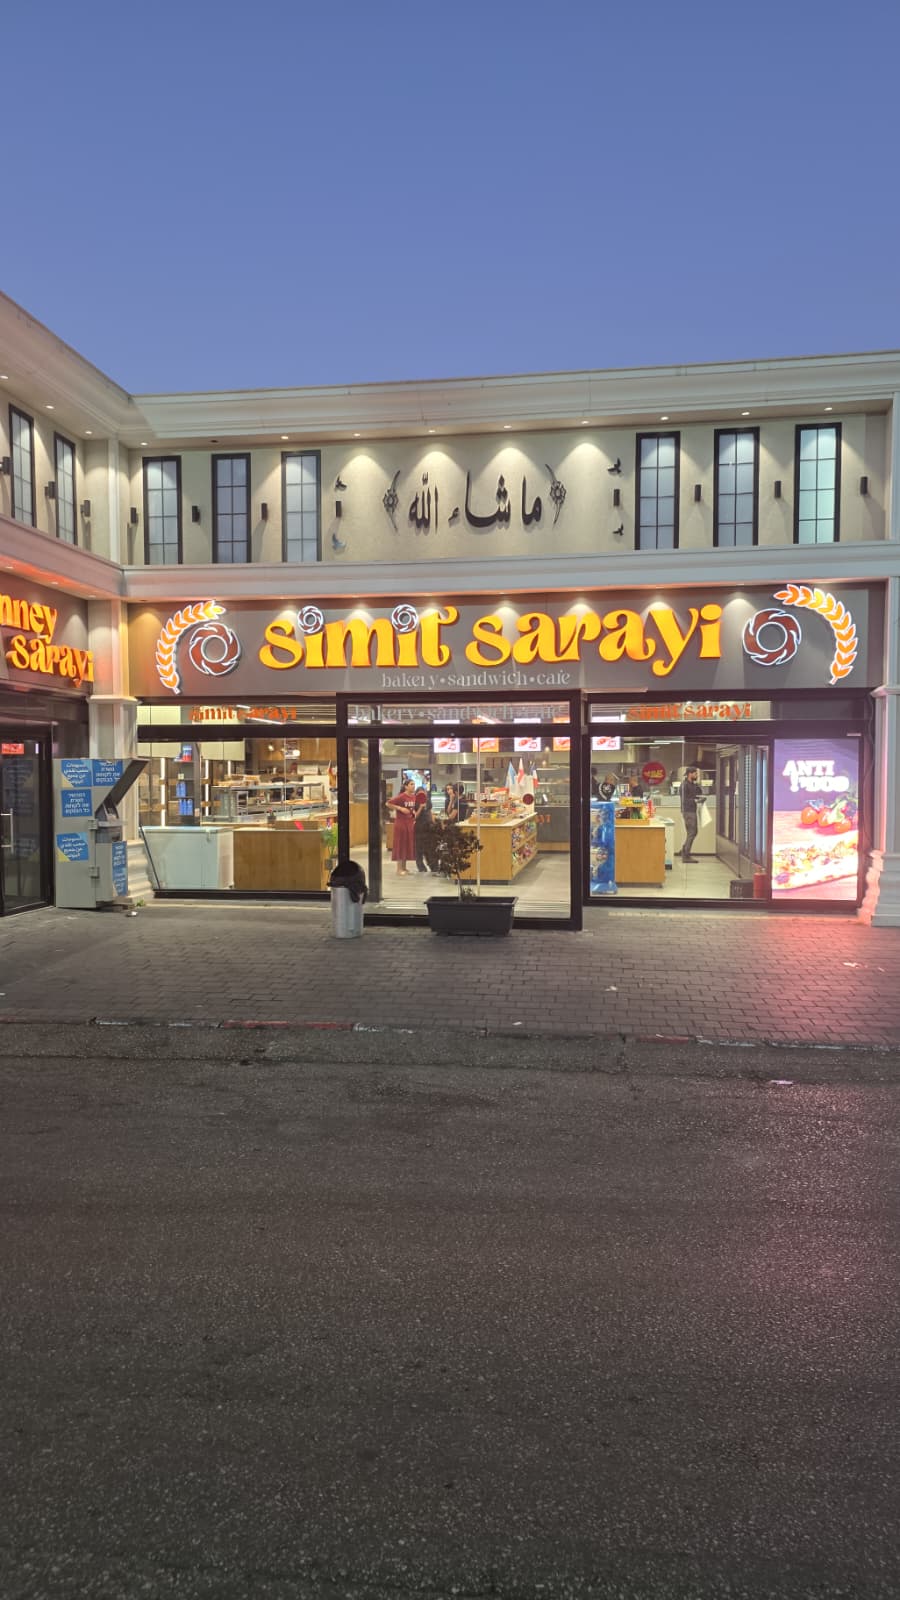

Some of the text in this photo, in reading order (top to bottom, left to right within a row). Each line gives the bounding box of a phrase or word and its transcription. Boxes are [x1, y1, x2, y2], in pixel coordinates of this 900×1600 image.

[409, 471, 438, 534] الله
[5, 634, 94, 689] sarayi
[258, 604, 722, 677] simit sarayi
[382, 672, 438, 691] bakery
[447, 669, 528, 687] sandwich
[683, 703, 751, 722] sarayi
